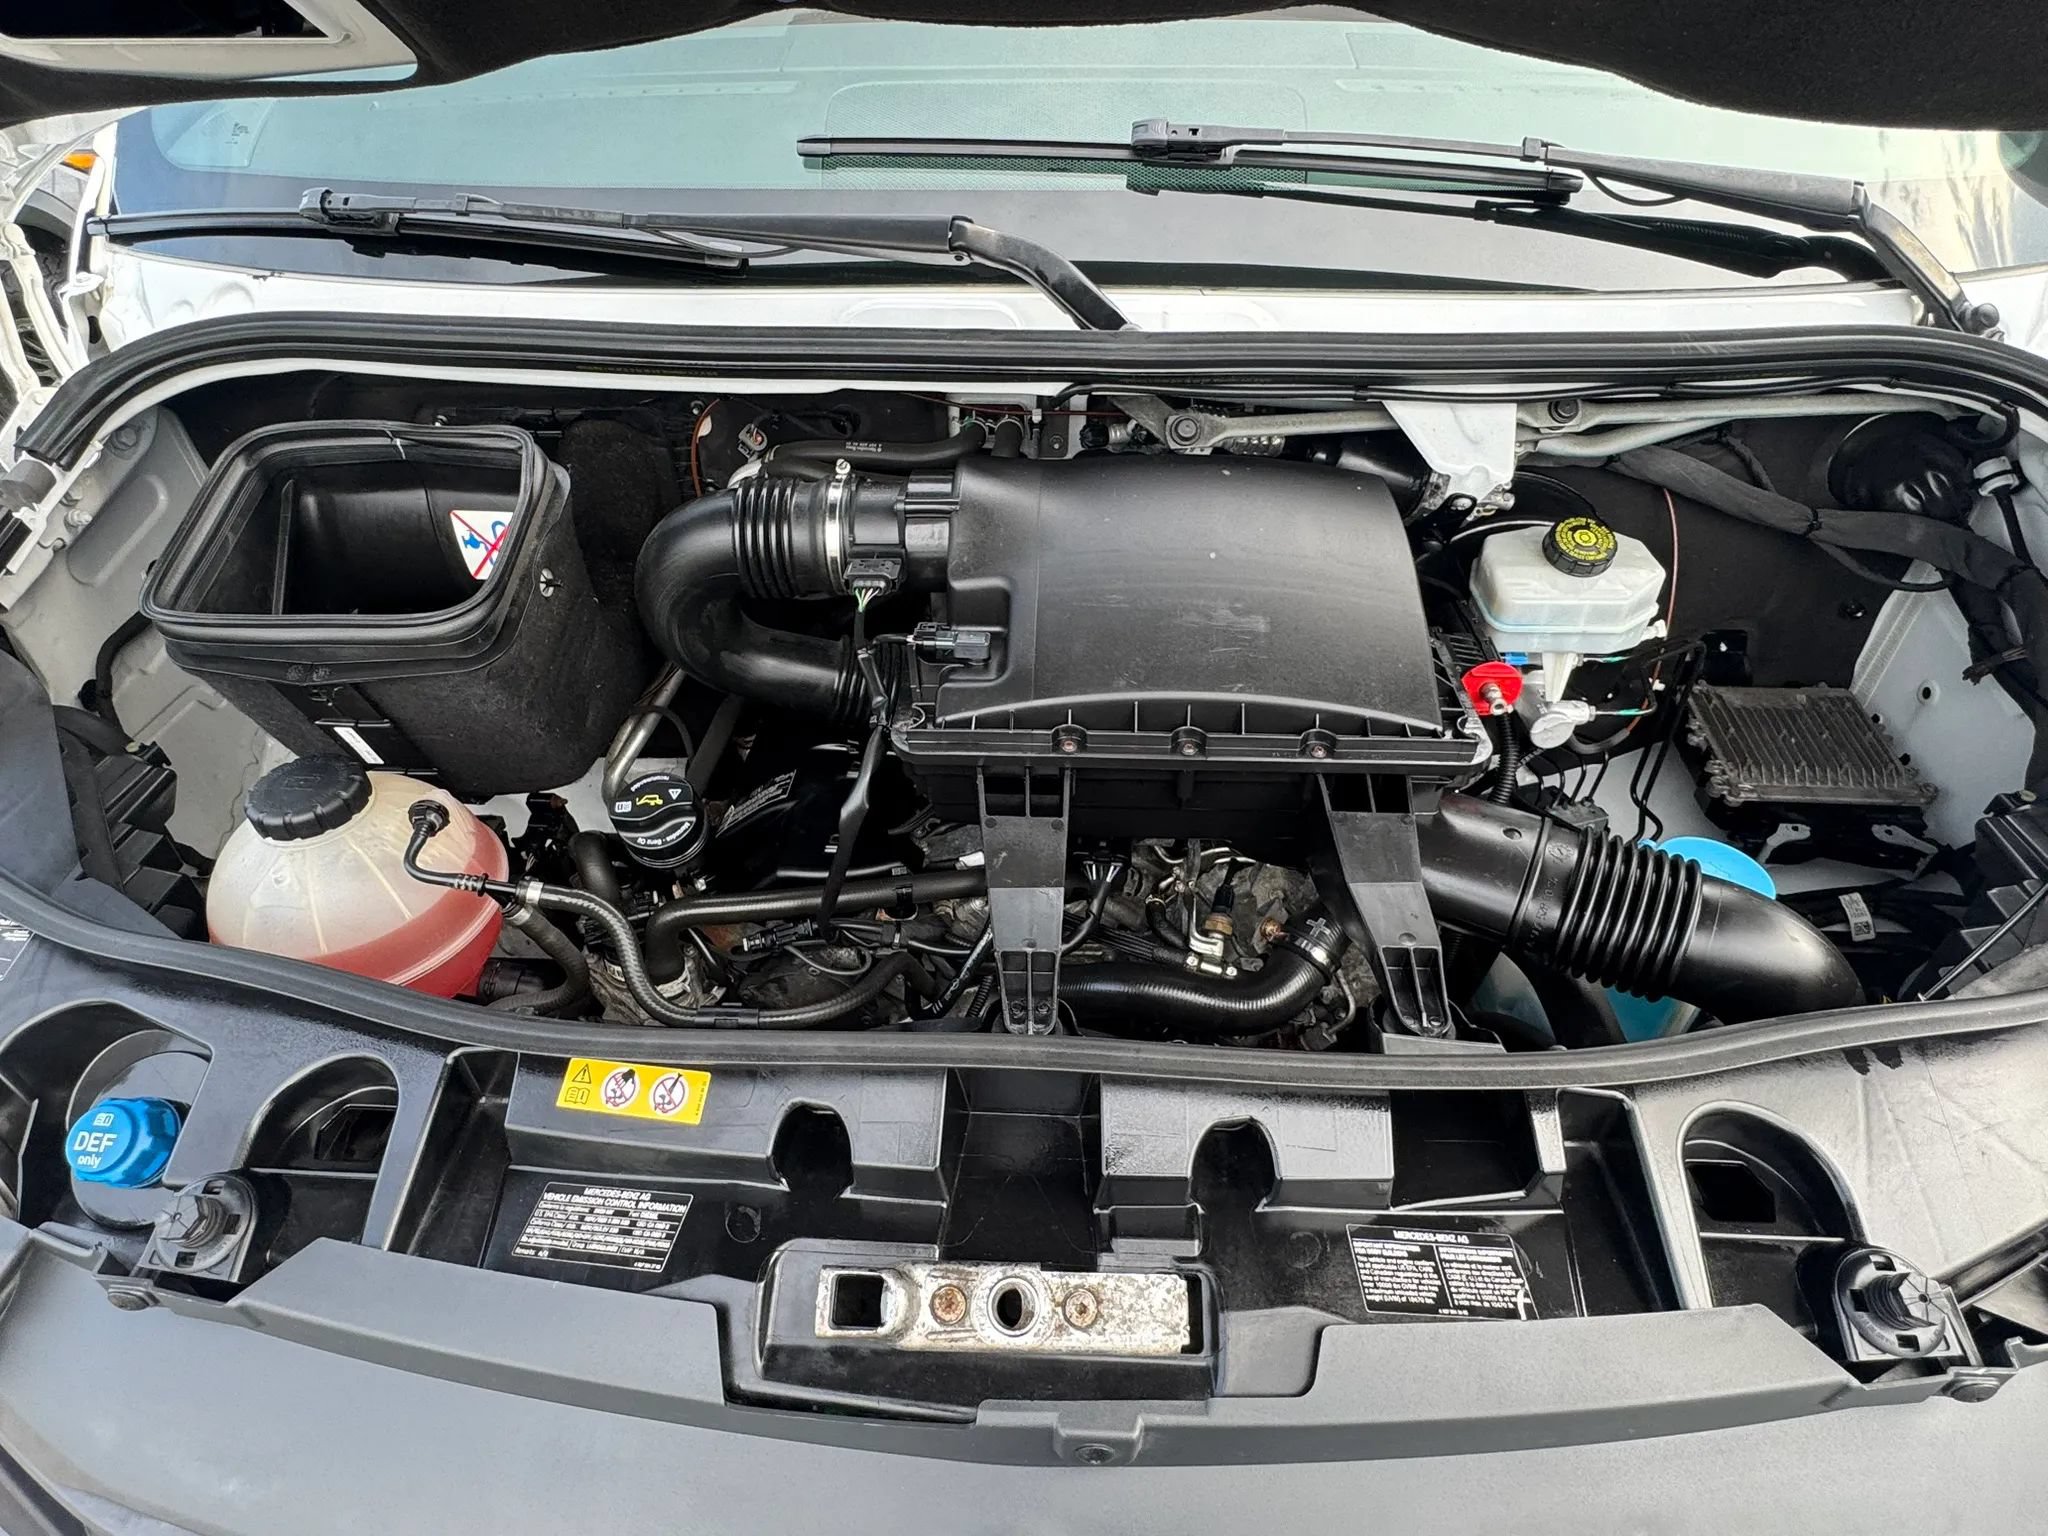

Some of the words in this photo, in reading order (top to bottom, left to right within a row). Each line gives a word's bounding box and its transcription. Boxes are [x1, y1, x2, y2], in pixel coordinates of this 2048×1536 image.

[631, 775, 670, 792] recommended
[73, 1131, 117, 1152] DEF
[77, 1154, 102, 1168] only
[542, 1193, 572, 1201] VEHICLE
[571, 1196, 605, 1205] EMISSION
[604, 1199, 638, 1208] CONTROL
[638, 1202, 687, 1212] INFORMATION
[584, 1189, 640, 1199] MERCEDES-BENZ
